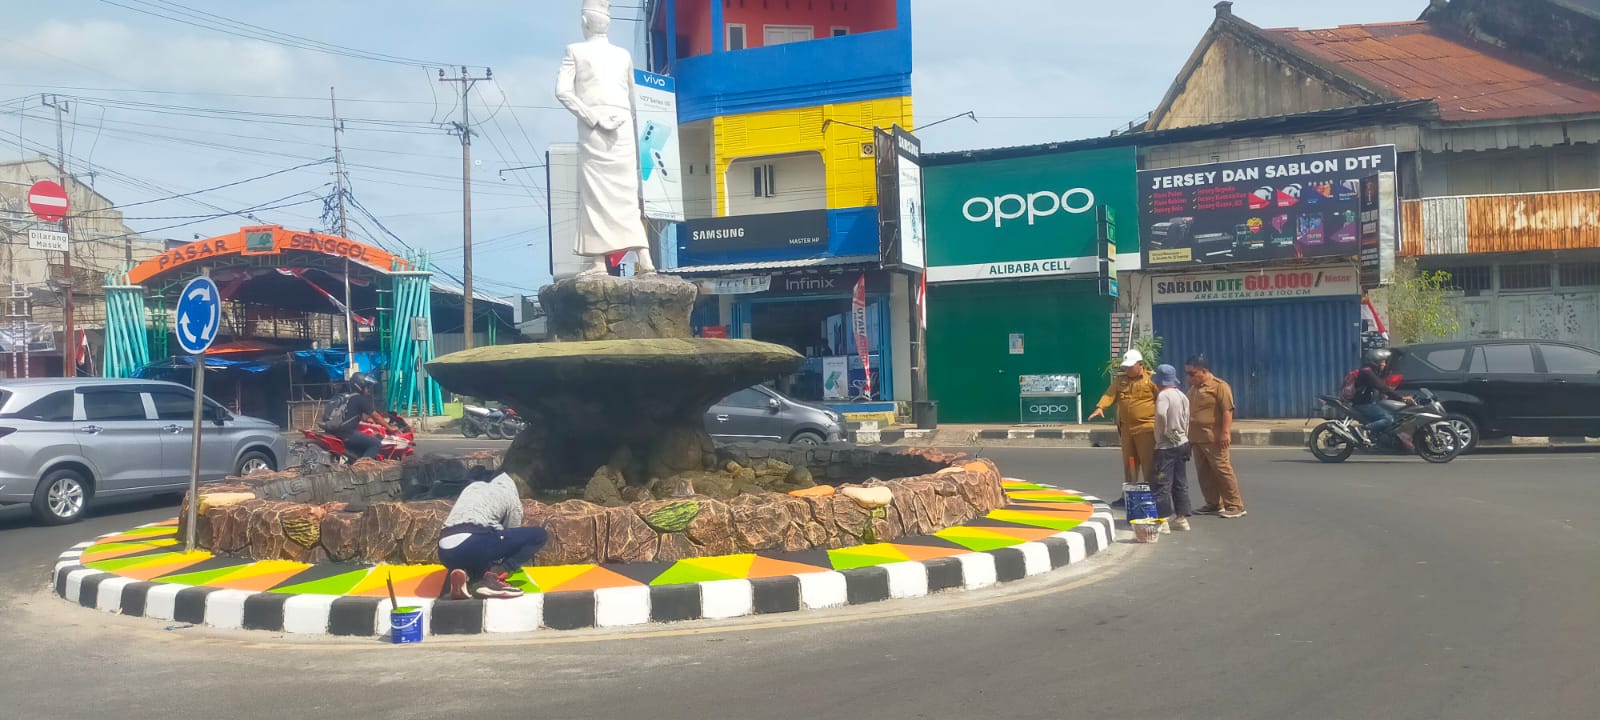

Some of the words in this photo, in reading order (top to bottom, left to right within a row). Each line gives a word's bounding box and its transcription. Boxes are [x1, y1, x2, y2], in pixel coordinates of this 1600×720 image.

[643, 74, 666, 87] vivo
[1152, 171, 1216, 190] JERSEY
[1222, 167, 1259, 183] DAN
[1265, 159, 1338, 178] SABLON
[1345, 155, 1382, 171] DTF
[962, 187, 1095, 228] oppo
[31, 232, 67, 242] Dilarang
[693, 228, 744, 240] SAMSUNG
[37, 241, 62, 249] Masuk
[160, 240, 227, 269] PASAR
[291, 234, 369, 261] SENGGOL
[989, 262, 1039, 275] ALIBABA
[1042, 261, 1070, 271] CELL
[785, 278, 834, 291] Infinix
[1157, 279, 1212, 295] SABLON
[1216, 278, 1243, 291] DTF
[1029, 404, 1069, 415] oppo
